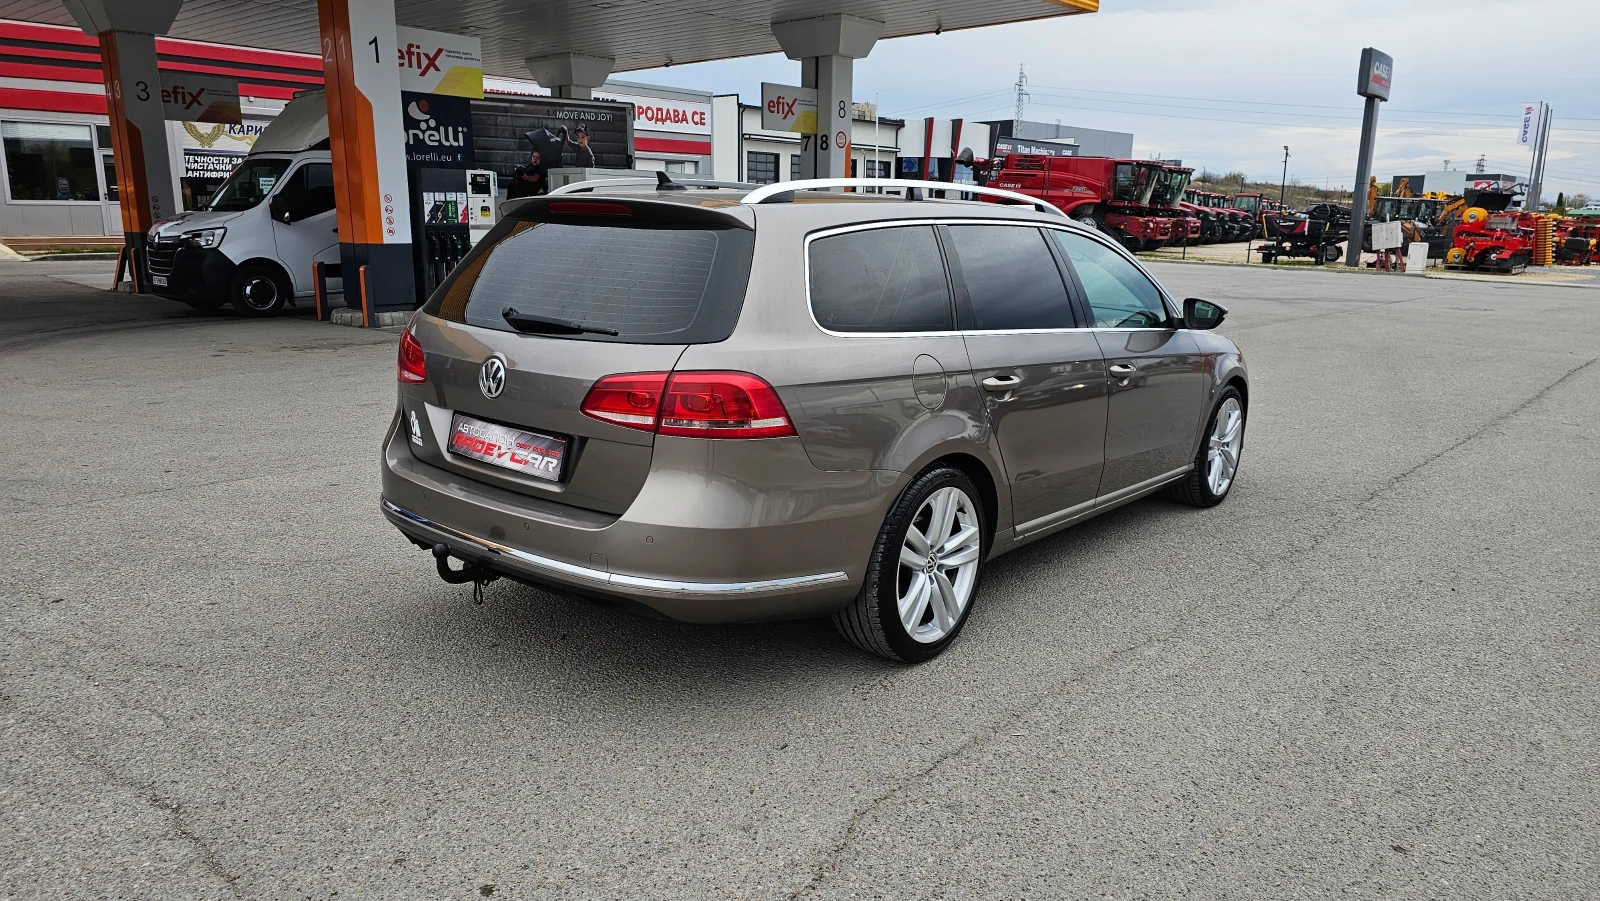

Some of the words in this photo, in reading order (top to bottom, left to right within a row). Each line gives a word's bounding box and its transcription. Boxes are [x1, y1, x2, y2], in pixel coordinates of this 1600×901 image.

[323, 37, 333, 62] 2
[339, 34, 346, 60] 1
[368, 36, 380, 63] 1
[106, 82, 112, 100] 4
[114, 80, 121, 99] 3
[135, 81, 150, 101] 3
[161, 85, 206, 110] efix
[556, 110, 579, 120] MOVE
[580, 111, 596, 121] AND
[597, 112, 613, 122] JOY!
[767, 95, 798, 120] efix
[838, 100, 847, 118] 8
[691, 111, 706, 126] СЕ
[228, 123, 266, 136] КАРИ
[802, 135, 811, 152] 7
[820, 134, 829, 151] 8
[1017, 144, 1031, 155] Titan
[184, 155, 230, 164] ТЕЧНОСТИ
[231, 157, 243, 165] ЗА
[185, 162, 233, 171] ЧИСТАЧКИ
[186, 170, 232, 179] АНТИФРИ
